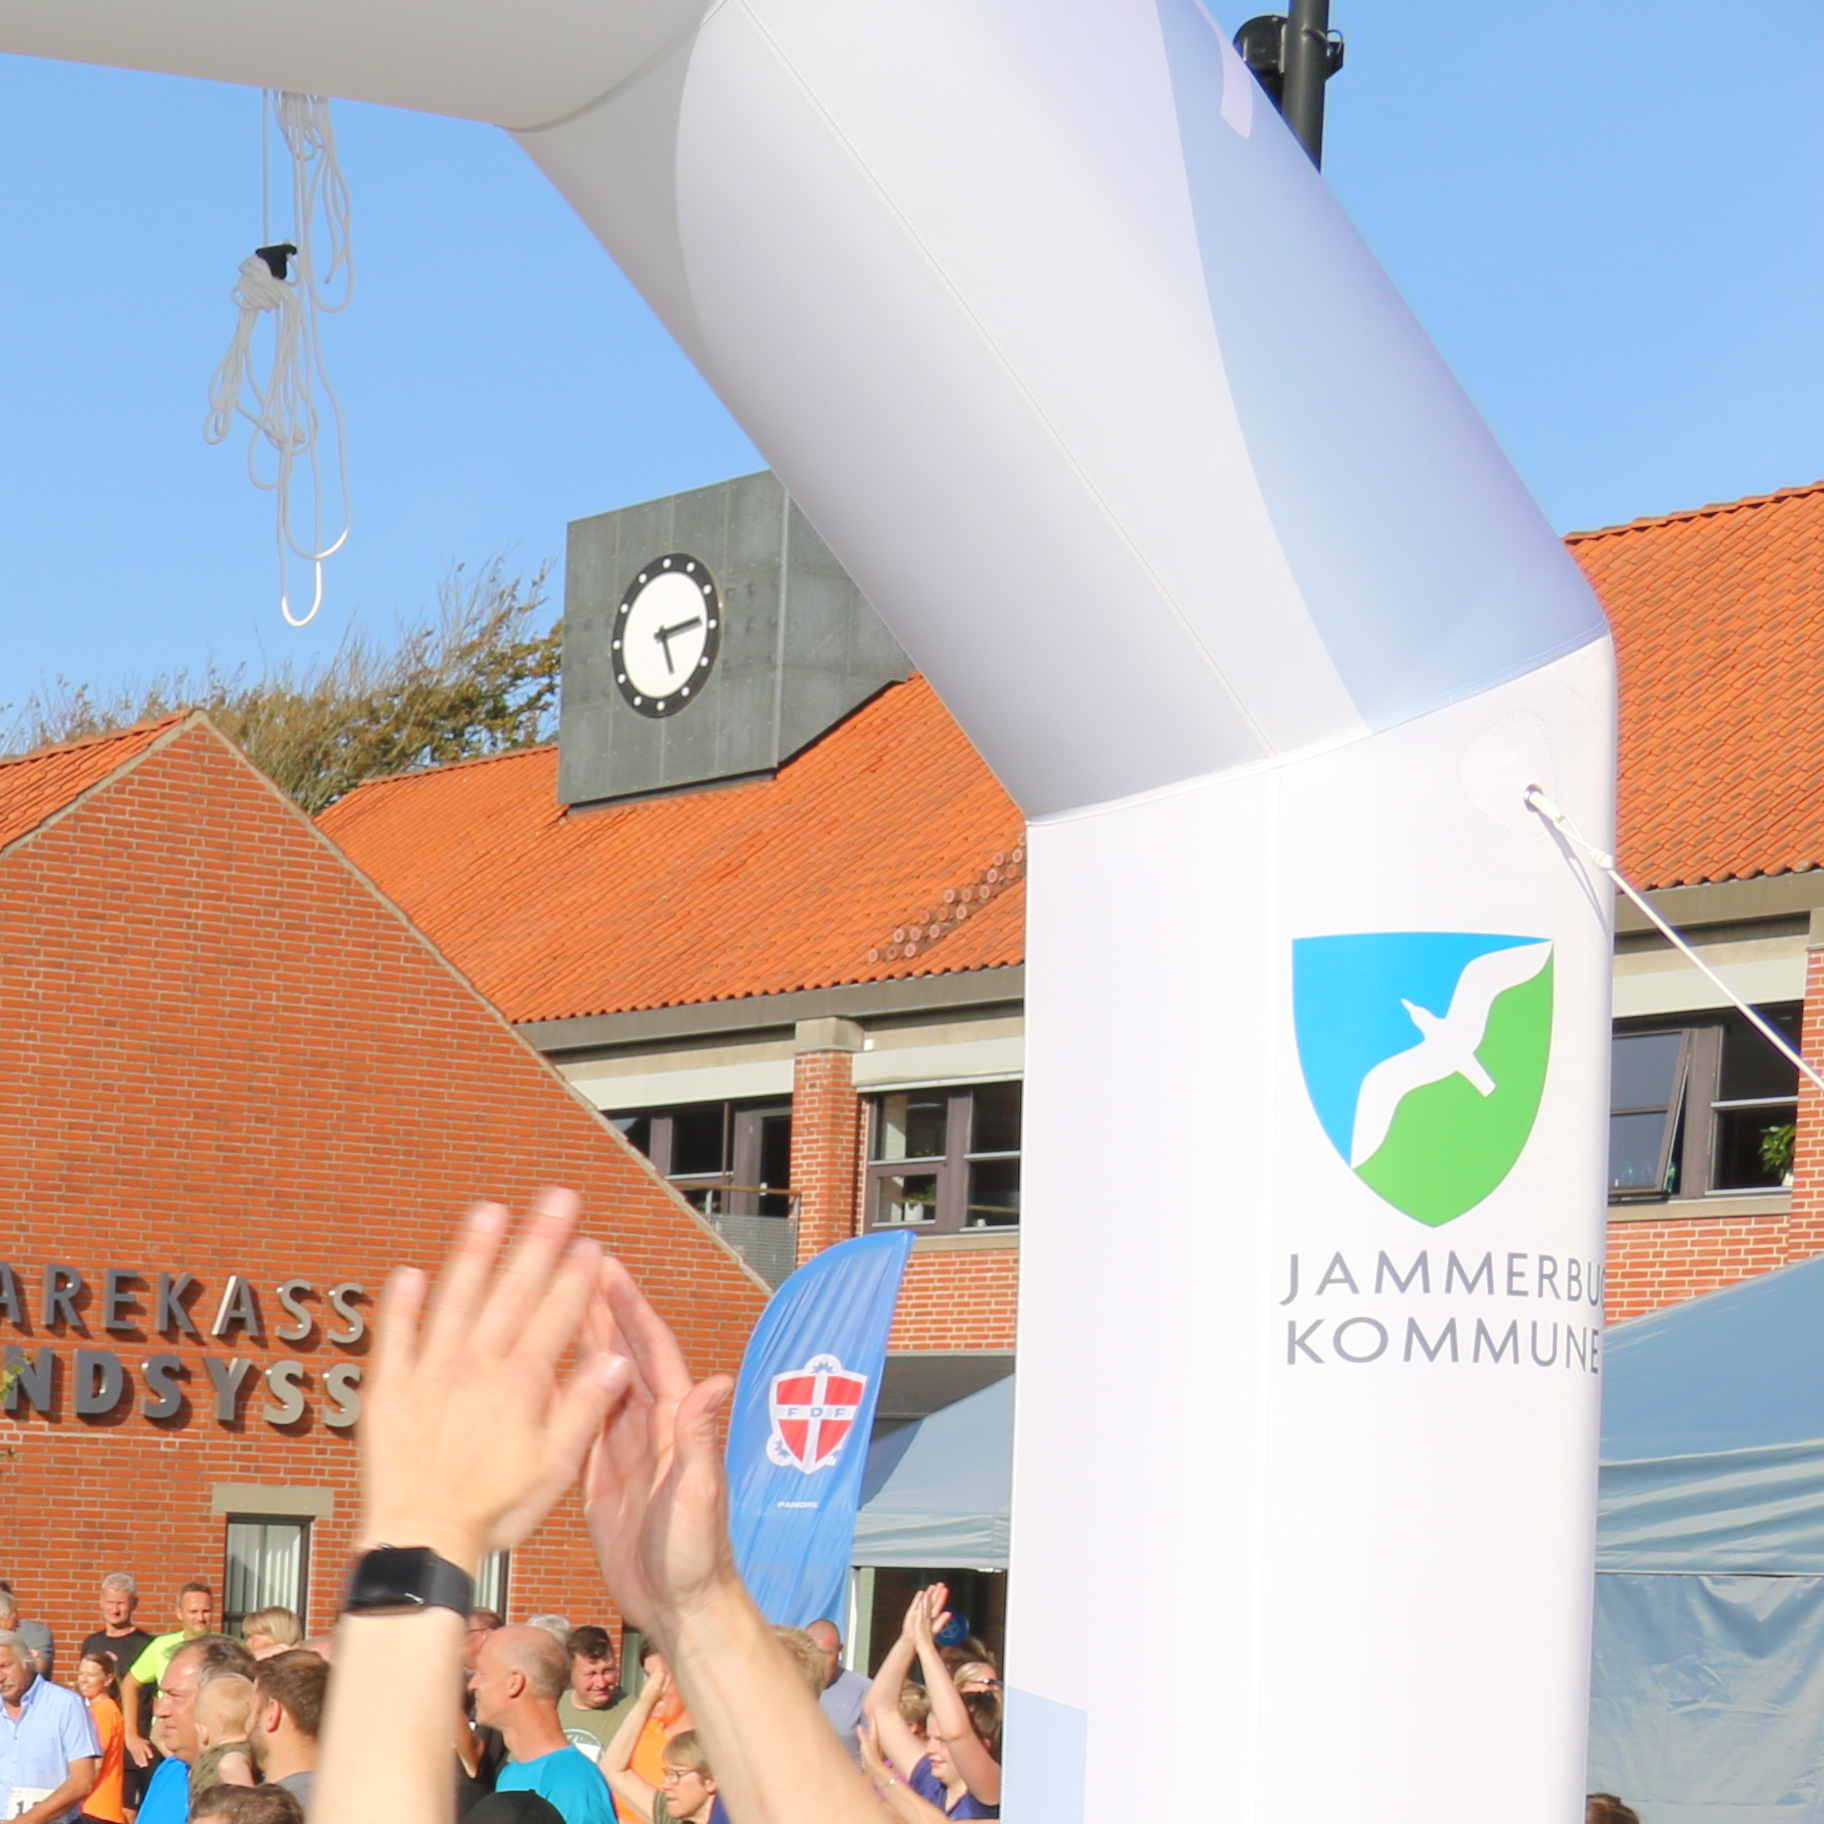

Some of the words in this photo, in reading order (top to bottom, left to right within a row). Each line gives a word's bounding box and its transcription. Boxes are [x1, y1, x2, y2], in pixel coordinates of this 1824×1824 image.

[1278, 1250, 1605, 1309] JAMMERBU
[1286, 1316, 1600, 1374] KOMMUNE
[787, 1407, 846, 1418] FDF
